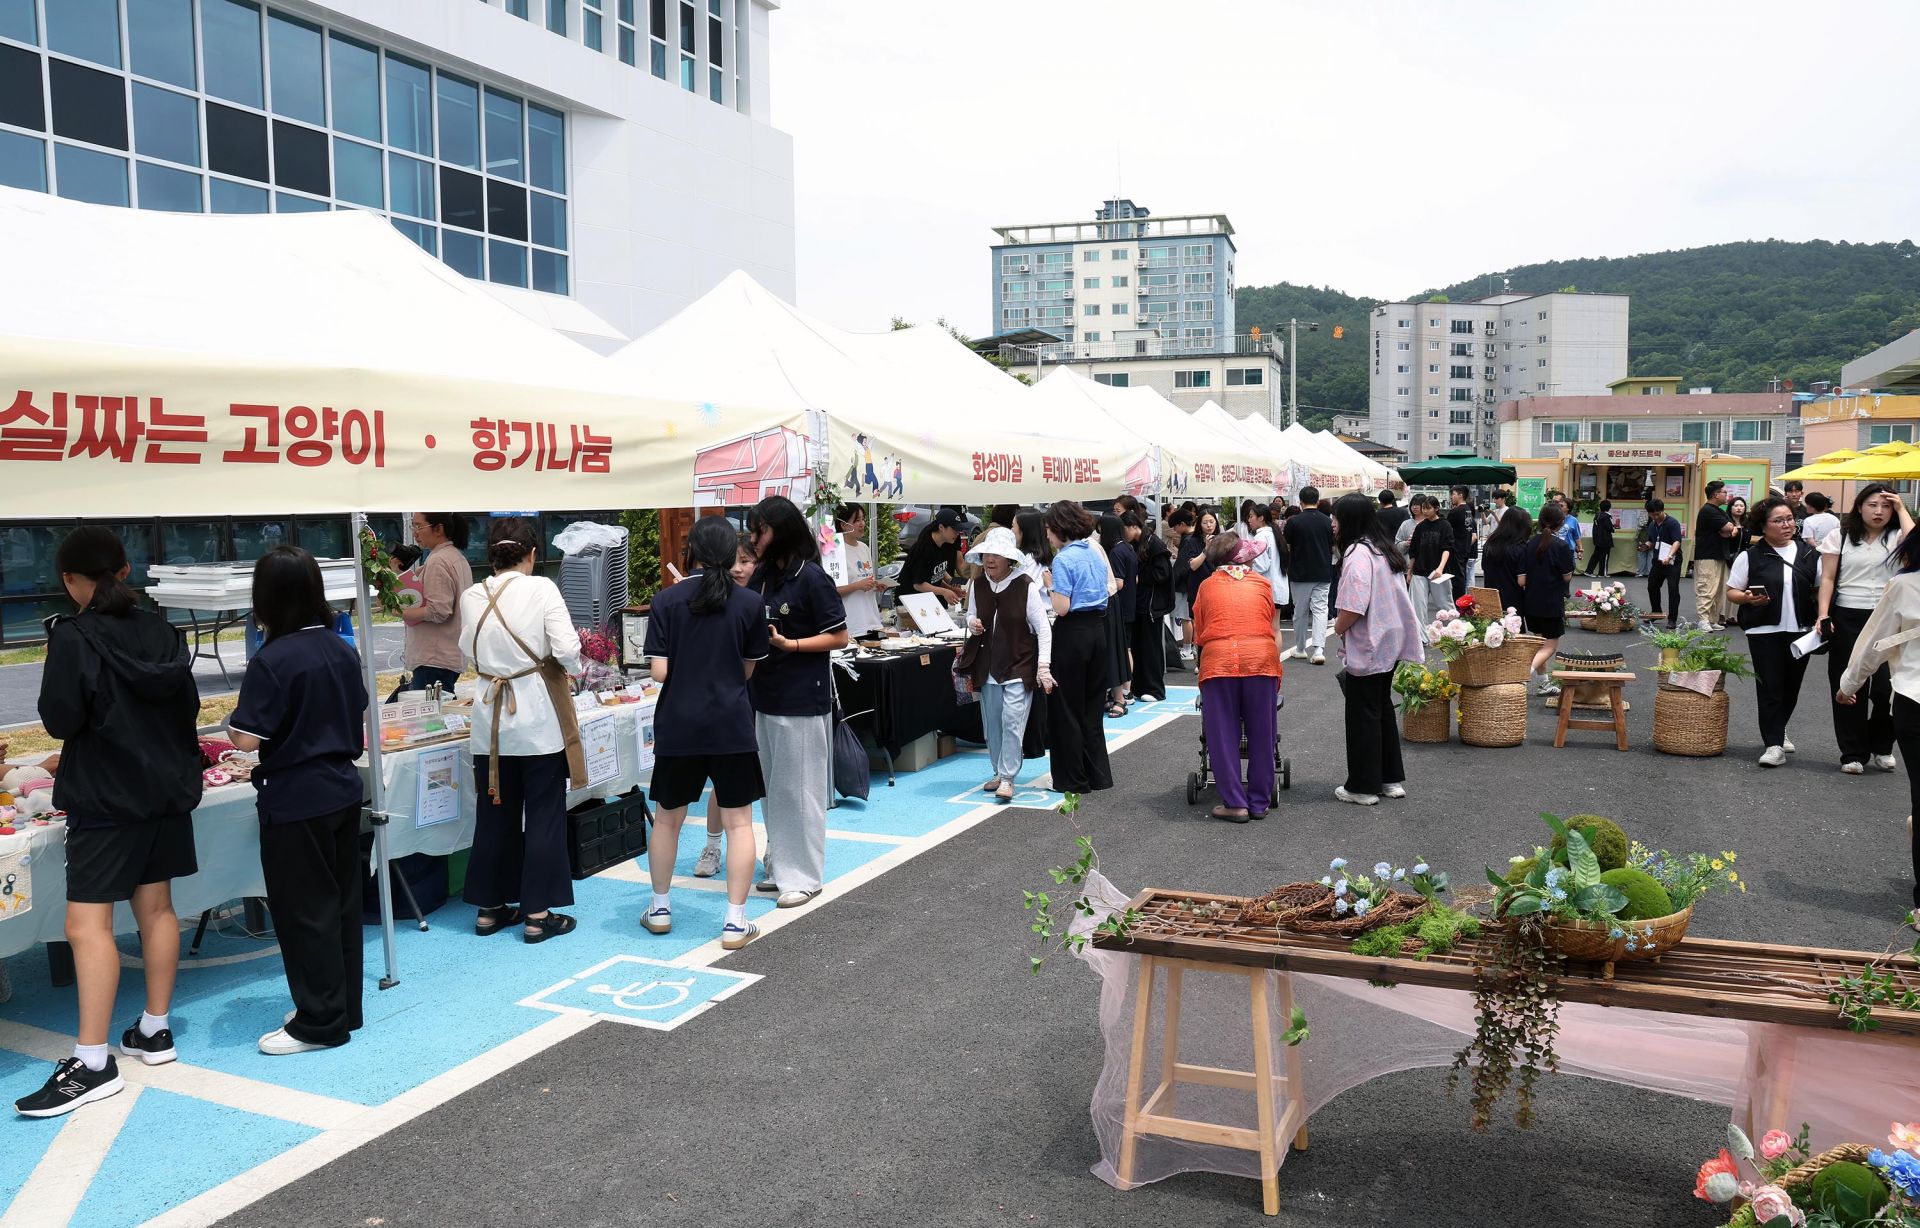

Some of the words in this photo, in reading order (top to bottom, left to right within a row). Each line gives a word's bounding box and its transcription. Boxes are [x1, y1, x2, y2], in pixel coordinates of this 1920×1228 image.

[0, 390, 208, 464] 실짜는
[222, 403, 385, 468] 고양이
[470, 416, 613, 473] 향기나눔
[1607, 449, 1630, 458] 좋은날
[1631, 449, 1662, 458] 푸드트럭
[972, 452, 1023, 483] 화성마실
[1042, 456, 1072, 484] 투데이
[1074, 457, 1101, 484] 샐러드
[1194, 462, 1216, 483] 유일무이
